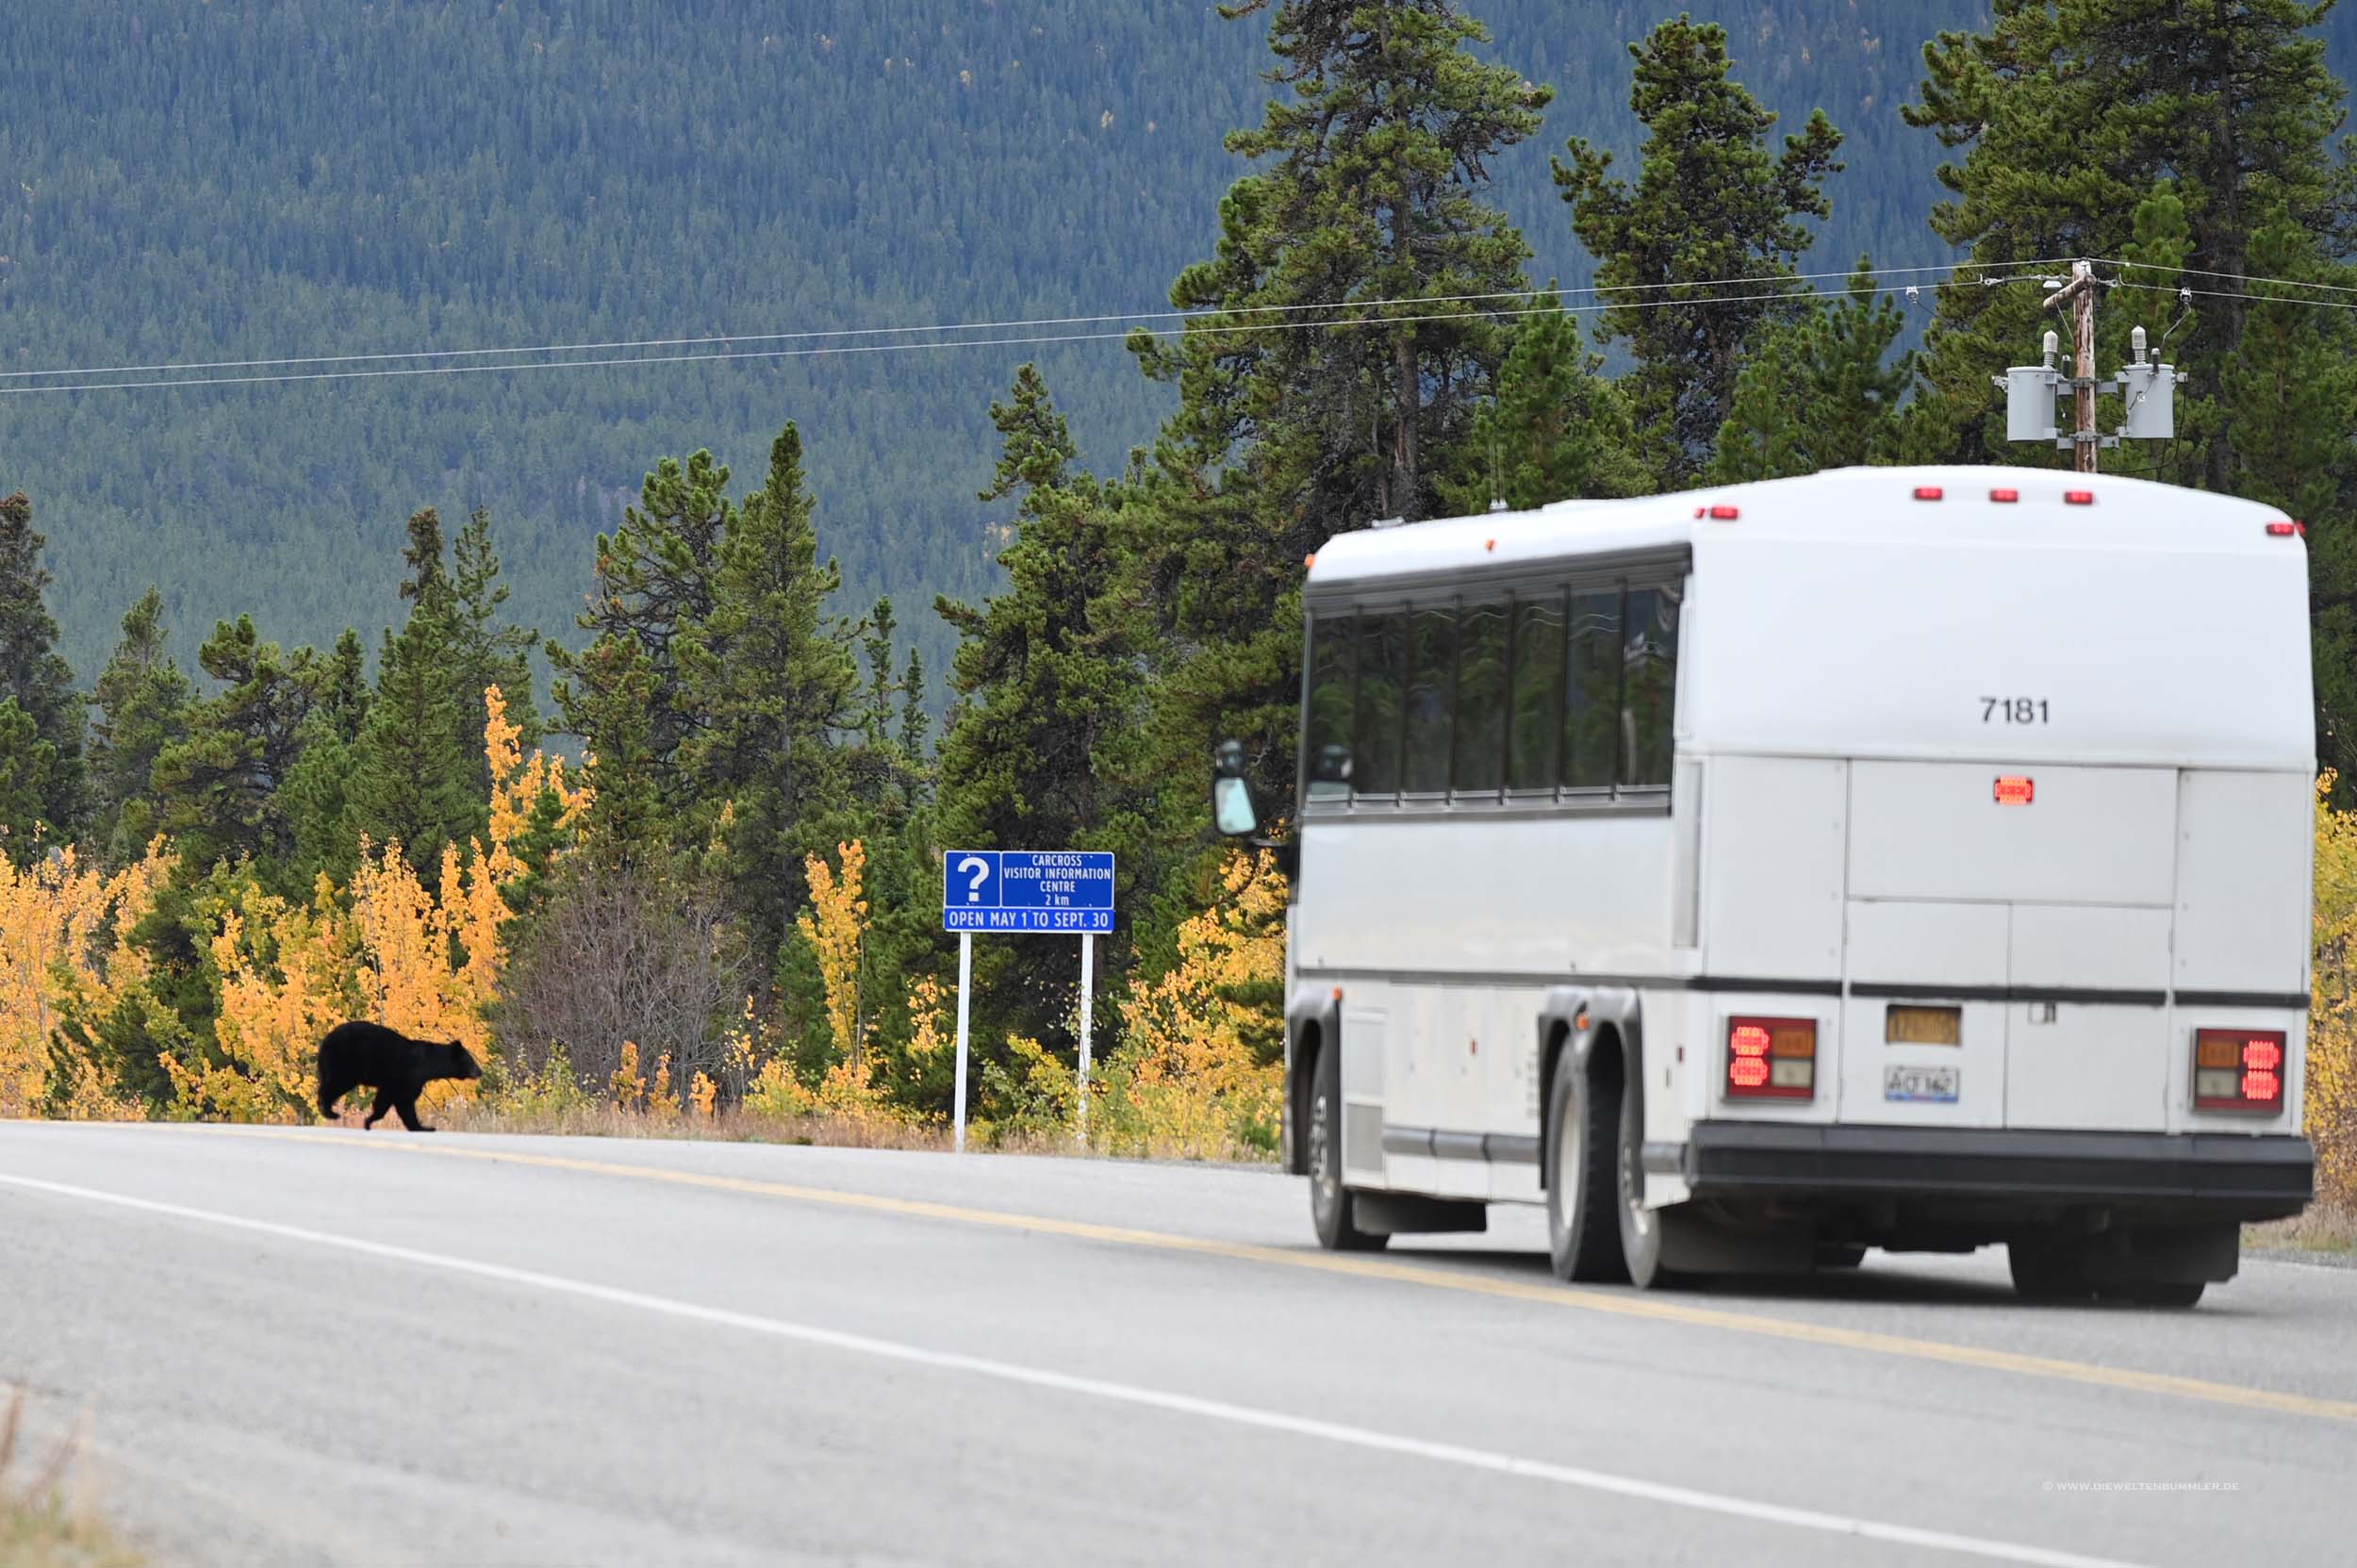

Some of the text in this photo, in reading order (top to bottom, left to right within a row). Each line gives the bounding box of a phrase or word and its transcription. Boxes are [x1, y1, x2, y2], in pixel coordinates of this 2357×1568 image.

[1979, 696, 2049, 724] 7181
[1031, 854, 1082, 867] CARCROSS
[957, 856, 990, 902] ?
[1003, 867, 1111, 880] VISITOR INFORMATION
[1040, 881, 1076, 893] CENTRE
[1045, 894, 1069, 905] 2 km
[949, 911, 1109, 928] OPEN MAY 1 TO SEPT. 30
